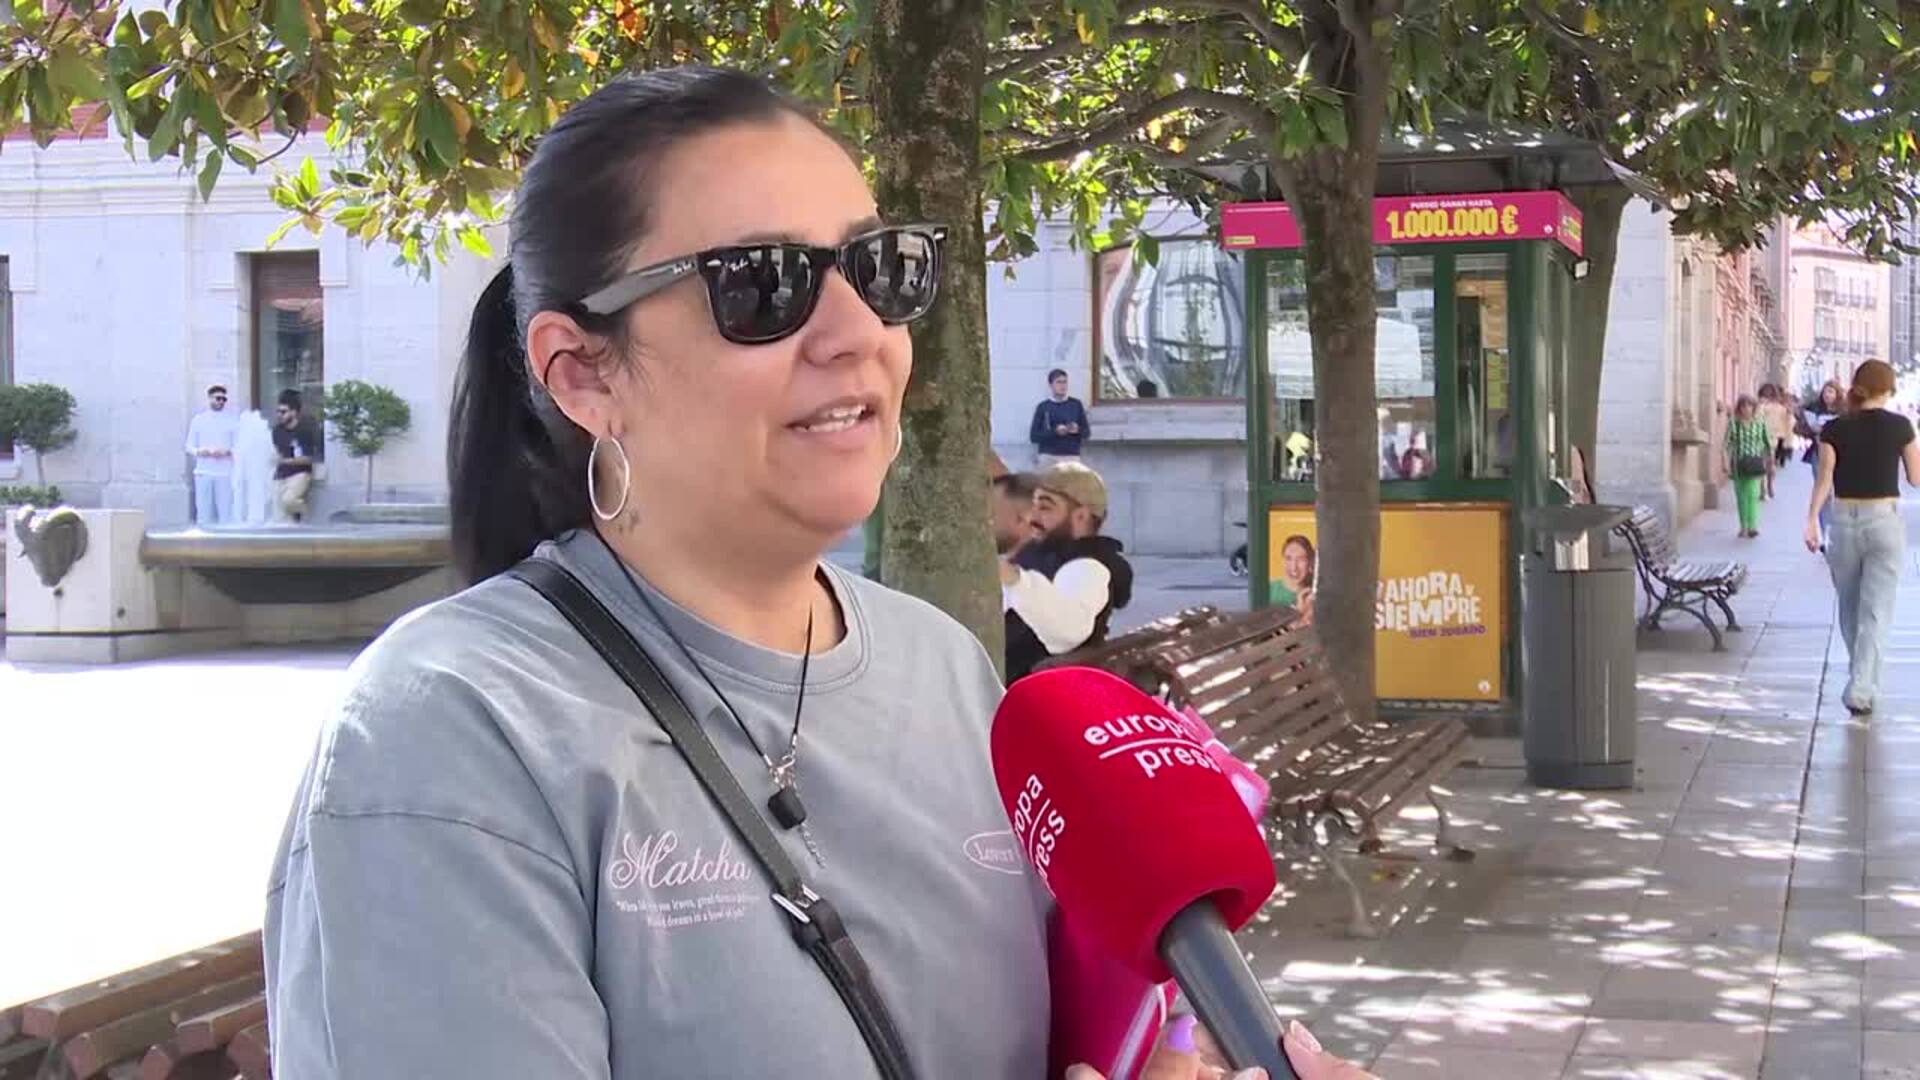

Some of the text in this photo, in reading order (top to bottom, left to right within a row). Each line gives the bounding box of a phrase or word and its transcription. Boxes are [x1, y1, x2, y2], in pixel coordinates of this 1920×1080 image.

[1385, 204, 1519, 239] 1.000.000 €
[1385, 570, 1463, 603] AHORA
[1375, 594, 1482, 632] SIEMPRE
[609, 829, 752, 889] Matcha
